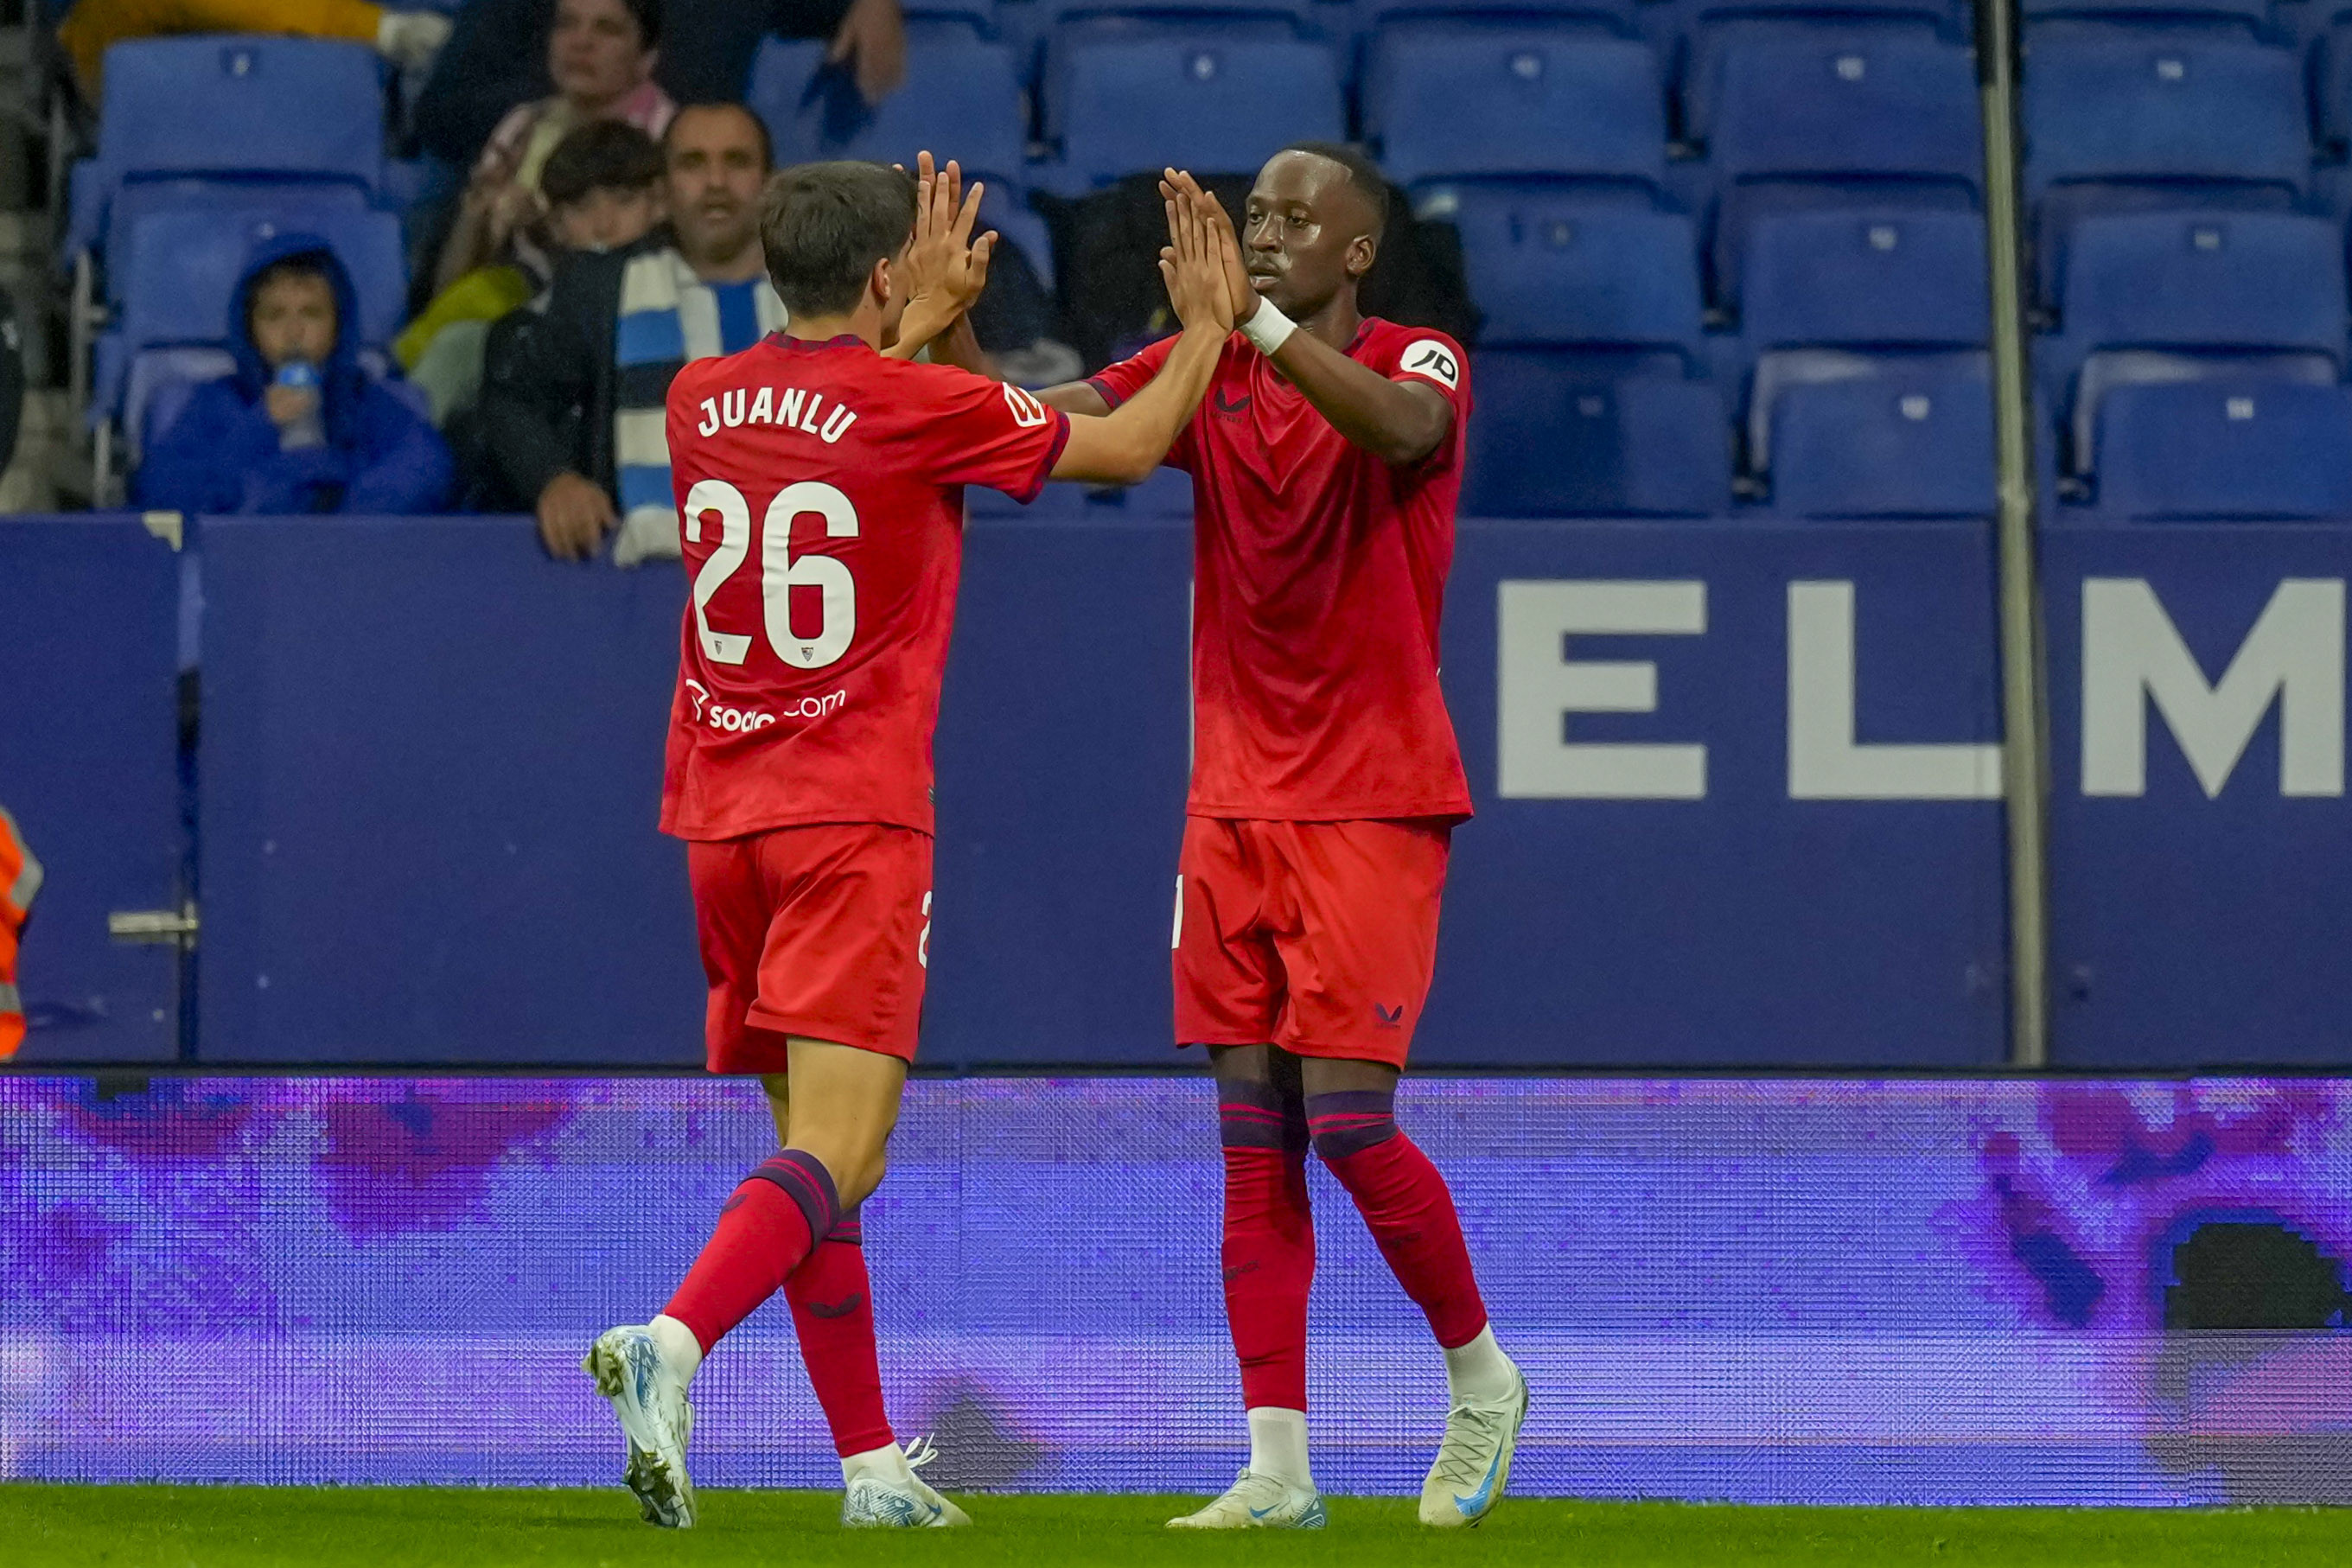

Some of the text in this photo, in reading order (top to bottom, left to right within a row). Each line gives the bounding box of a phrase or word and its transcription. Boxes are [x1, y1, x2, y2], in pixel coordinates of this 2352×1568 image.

[1410, 348, 1456, 383] JD
[698, 386, 858, 444] JUANLU
[684, 478, 861, 670] 26
